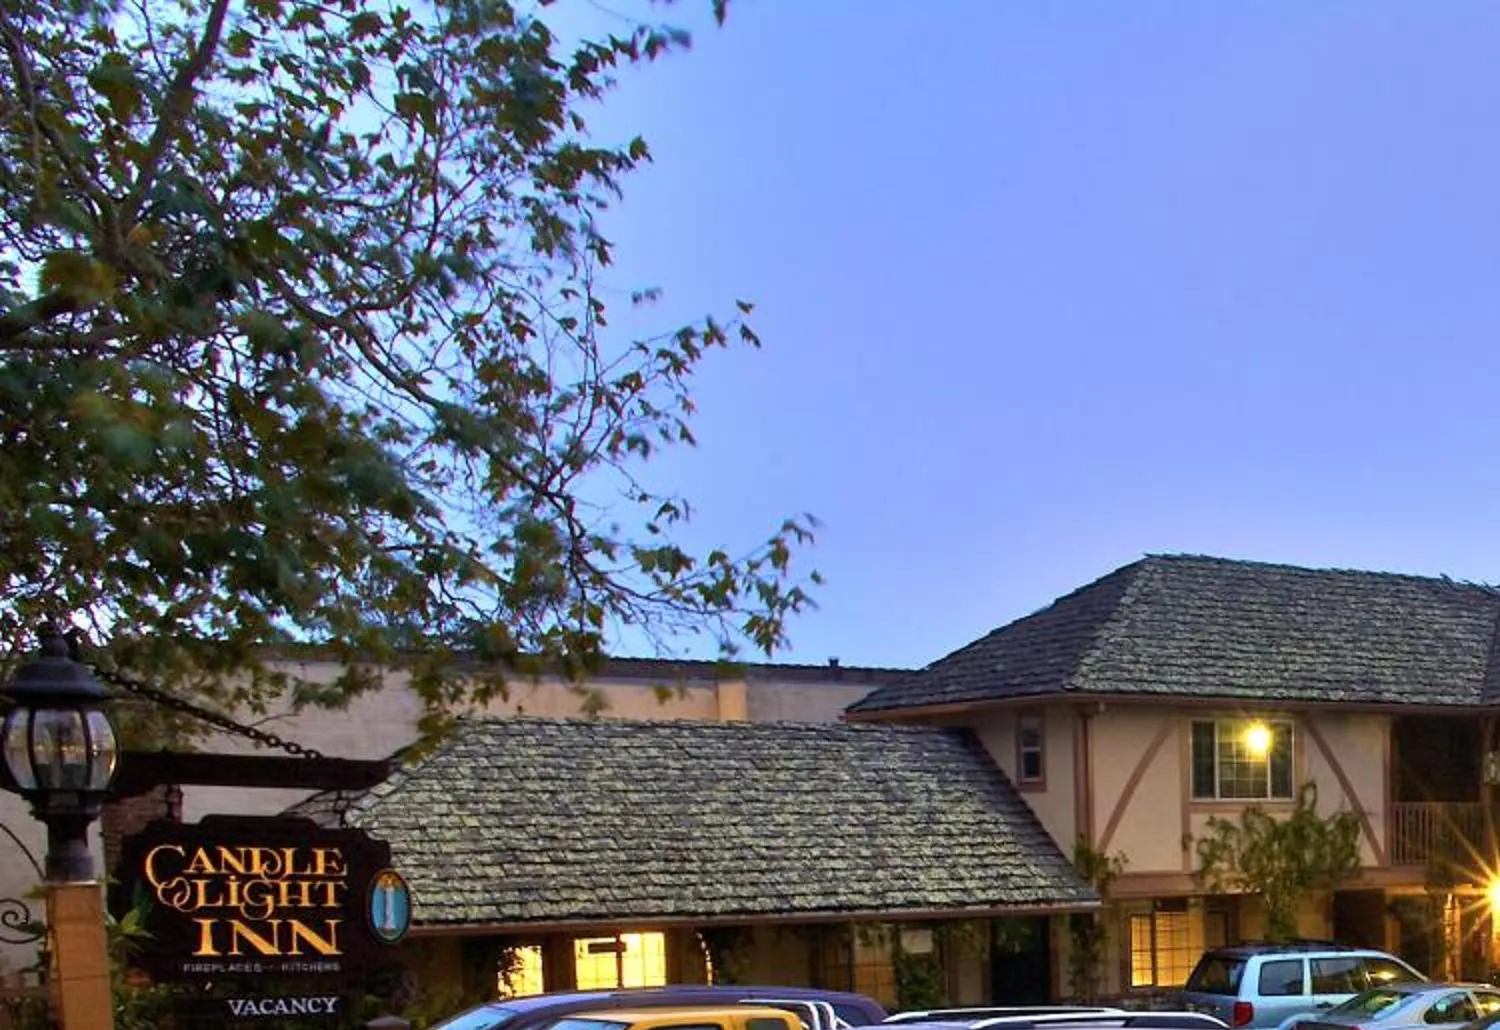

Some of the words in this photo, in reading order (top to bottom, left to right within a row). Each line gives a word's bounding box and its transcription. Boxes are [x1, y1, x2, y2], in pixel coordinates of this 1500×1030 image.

[145, 845, 348, 886] CANDLE
[191, 918, 345, 957] INN
[227, 997, 339, 1016] VACANCY
